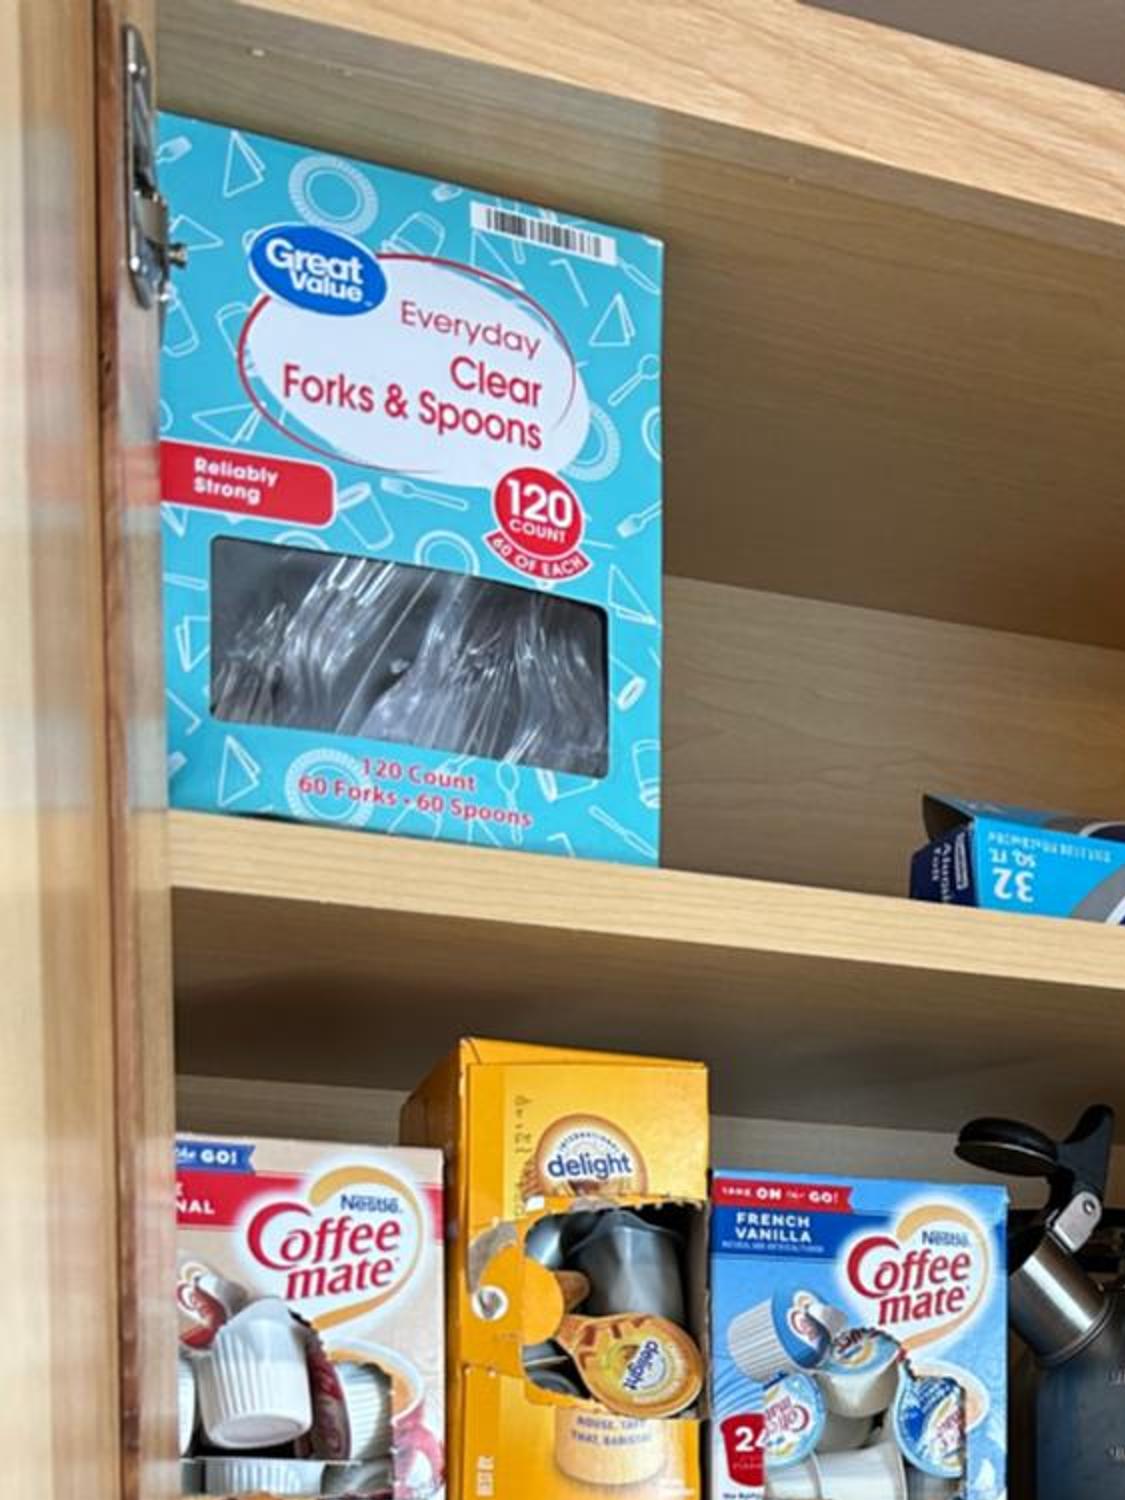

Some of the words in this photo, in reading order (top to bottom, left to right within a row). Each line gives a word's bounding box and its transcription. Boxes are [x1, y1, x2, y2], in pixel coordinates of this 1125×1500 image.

[265, 237, 364, 285] Great
[291, 270, 363, 303] Value
[400, 300, 541, 360] Everyday
[450, 356, 542, 407] Clear
[283, 363, 376, 413] Forks
[384, 384, 409, 419] &
[419, 389, 542, 450] Spoons
[193, 457, 278, 488] Reliably
[193, 476, 261, 505] Strong
[506, 479, 573, 529] 120
[508, 518, 567, 544] COUNT
[492, 537, 513, 557] 60
[514, 555, 538, 572] OF
[541, 554, 585, 578] EACH
[362, 758, 399, 781] 120
[409, 761, 476, 792] Count
[299, 777, 328, 796] 60
[334, 779, 397, 807] Forks
[416, 793, 444, 812] 60
[450, 798, 532, 827] Spoons
[992, 868, 1035, 902] 32
[200, 1148, 237, 1166] GO!
[547, 1153, 633, 1181] delight
[756, 1187, 782, 1200] ON
[808, 1191, 839, 1204] GO!
[247, 1202, 401, 1270] Coffee
[735, 1227, 812, 1244] VANILLA
[736, 1211, 811, 1228] FRENCH
[285, 1258, 393, 1300] mate
[846, 1235, 971, 1298] Coffee
[878, 1286, 967, 1325] mate
